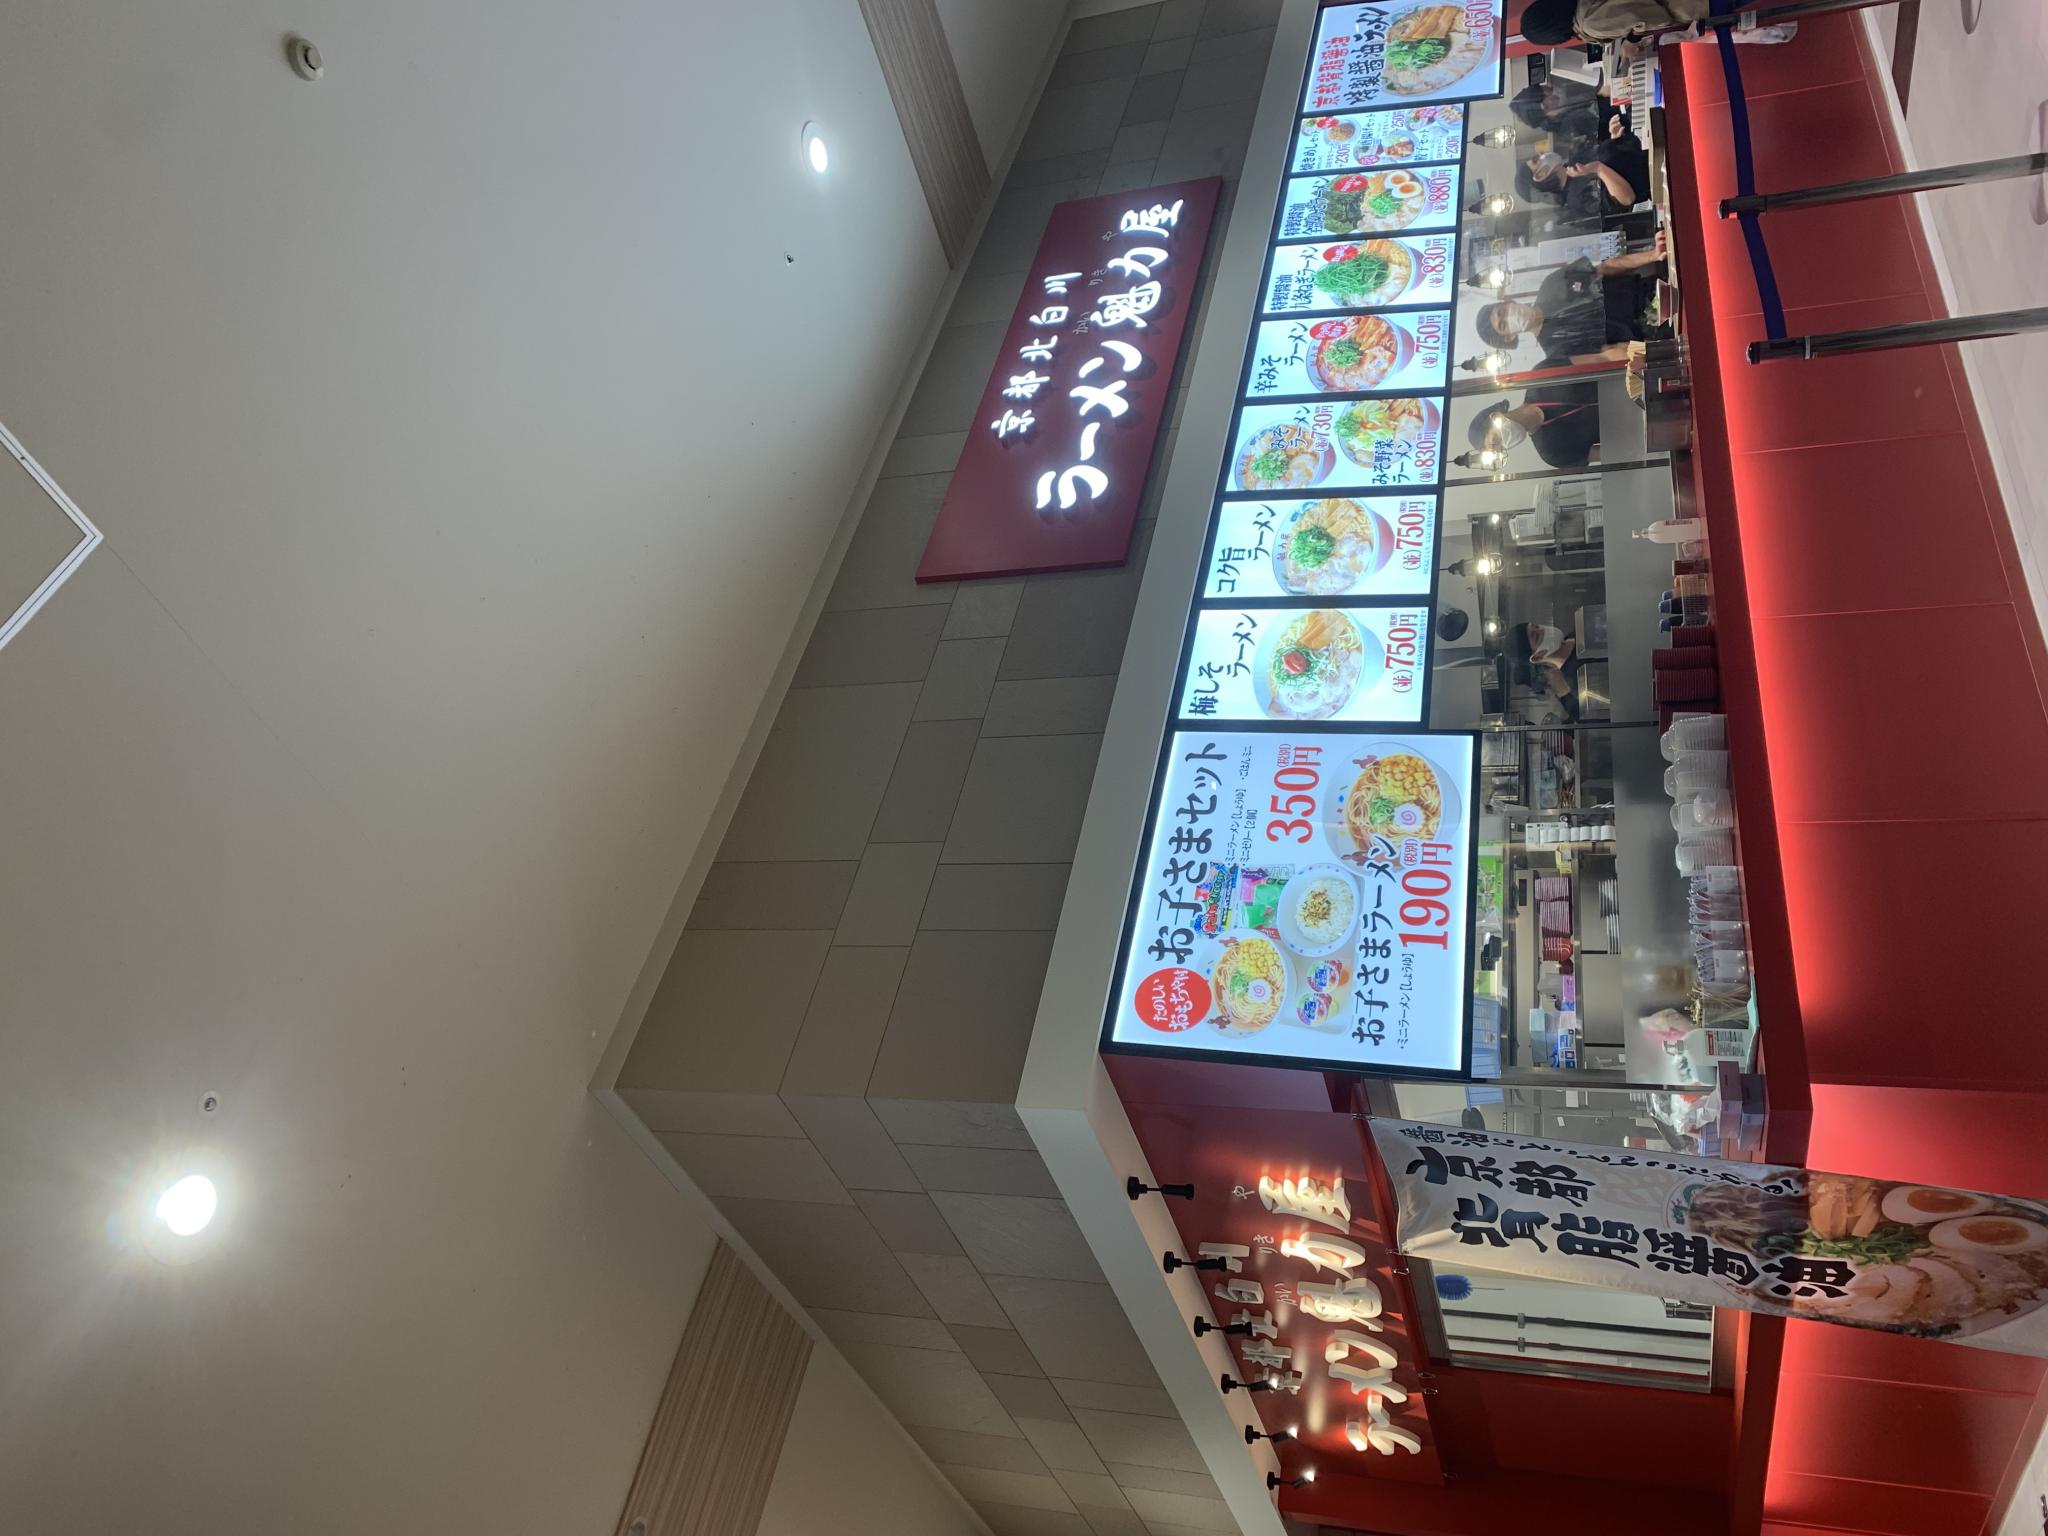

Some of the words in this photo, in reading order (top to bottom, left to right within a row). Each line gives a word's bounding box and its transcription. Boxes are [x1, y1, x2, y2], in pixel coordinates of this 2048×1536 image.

[1312, 34, 1350, 108] 京都背脂醤油
[1344, 6, 1390, 106] 特製醤油ラーメン
[1283, 202, 1306, 236] 特製醤油
[1270, 274, 1294, 311] 特製醤油
[1289, 246, 1319, 310] 九条ねぎラーメン
[990, 271, 1083, 438] 京都北白川
[1283, 321, 1308, 367] ラーメン
[1253, 354, 1283, 394] 辛みそ
[1270, 425, 1290, 450] みそ
[1290, 405, 1311, 449] ラーメン
[1371, 438, 1395, 485] みそ野菜
[1391, 438, 1412, 483] ラーメン
[1247, 503, 1276, 561] ラーメン
[1215, 547, 1246, 593] コク旨
[1225, 613, 1258, 678] ラーメン
[1187, 661, 1224, 716] 梅しそ
[1265, 745, 1323, 843] 350円
[1147, 742, 1228, 965] お子さまセット
[1398, 841, 1454, 951] 190円
[1351, 835, 1397, 1047] お子さまラーメン
[1151, 978, 1169, 1023] たのしい
[1168, 969, 1193, 1031] おもちゃ付
[1405, 1146, 1596, 1207] 京都
[1450, 1192, 1856, 1298] 背脂醤油
